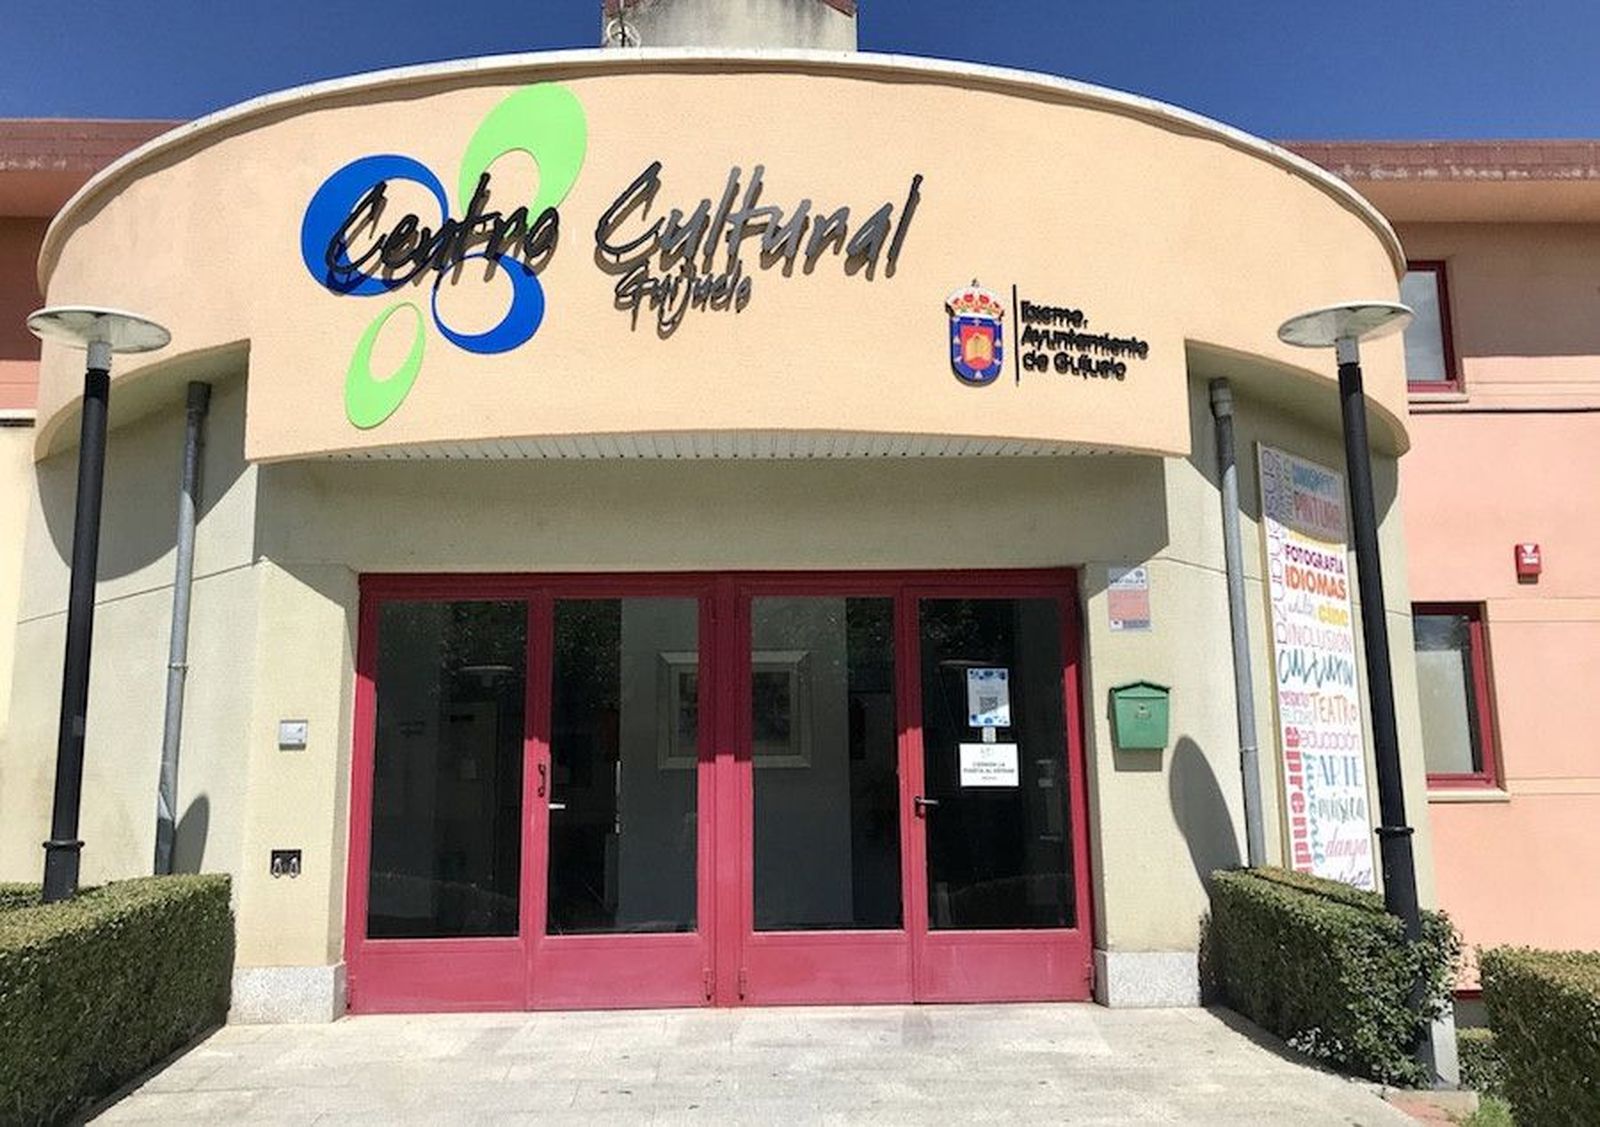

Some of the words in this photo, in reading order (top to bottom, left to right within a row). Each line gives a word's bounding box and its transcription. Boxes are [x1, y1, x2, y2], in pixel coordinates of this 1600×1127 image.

[325, 172, 560, 294] Centro
[594, 160, 923, 279] Cultural
[614, 261, 752, 338] Guijuelo
[1021, 325, 1149, 360] Ayuntamiento
[1022, 351, 1049, 373] de
[1054, 352, 1127, 380] Guijuelo
[1285, 544, 1344, 574] FOTOGRAFÍA
[1285, 564, 1346, 600] IDIOMAS
[1319, 755, 1362, 787] ARTE
